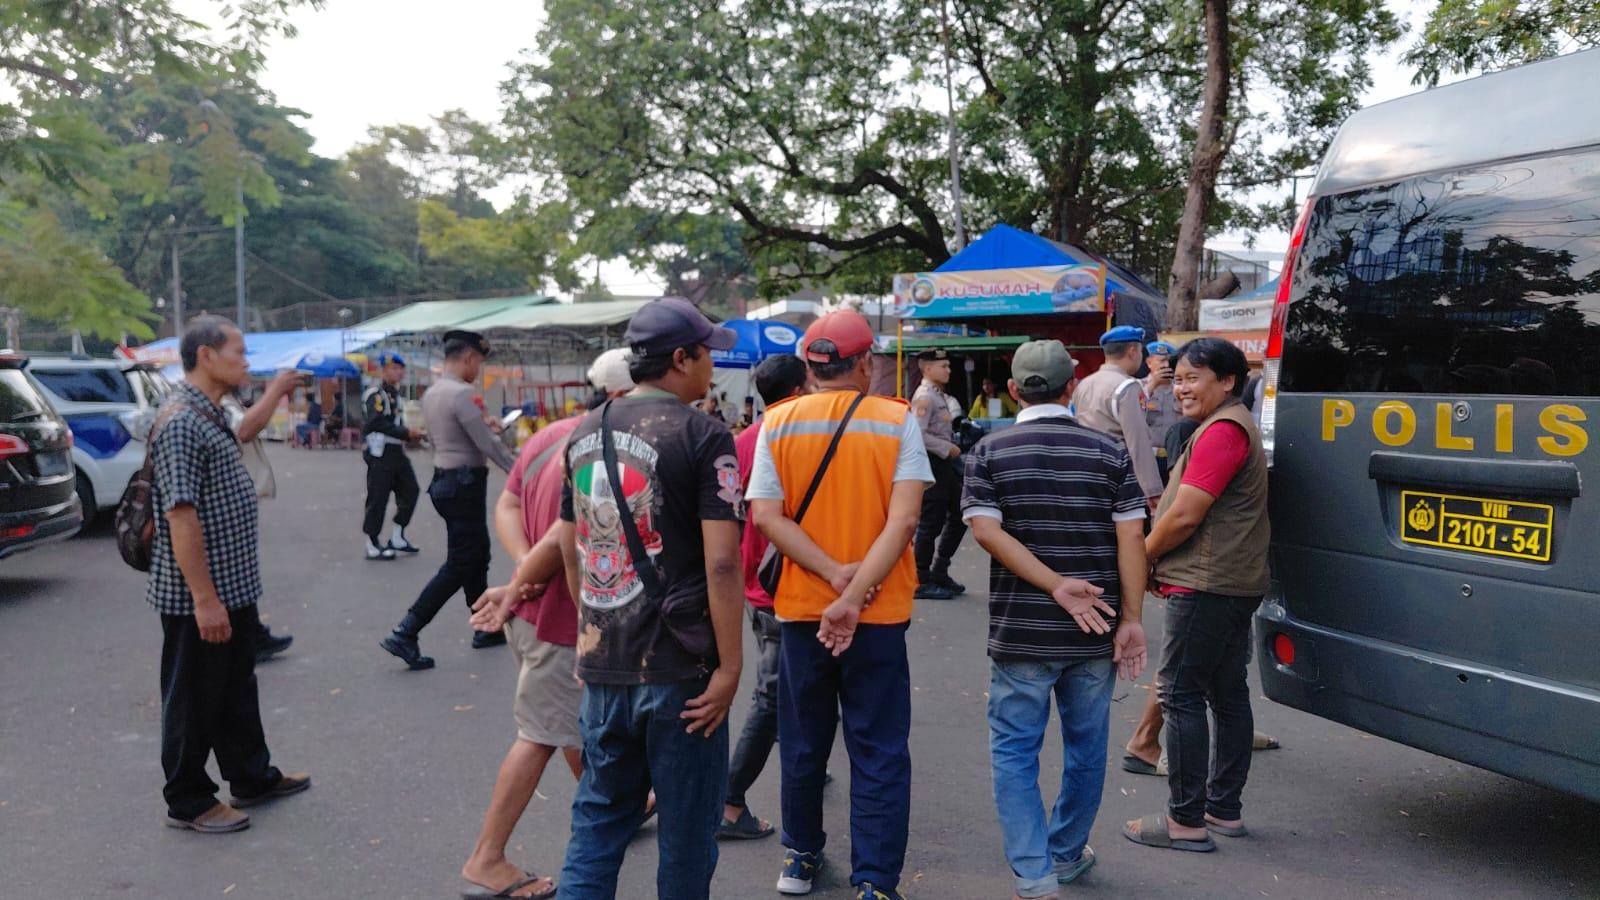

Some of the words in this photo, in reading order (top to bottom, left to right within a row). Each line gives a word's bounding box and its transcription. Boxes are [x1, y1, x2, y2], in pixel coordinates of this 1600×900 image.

[939, 283, 1041, 298] KUSUMAH
[1321, 399, 1589, 457] POLIS
[1482, 502, 1509, 519] VIII
